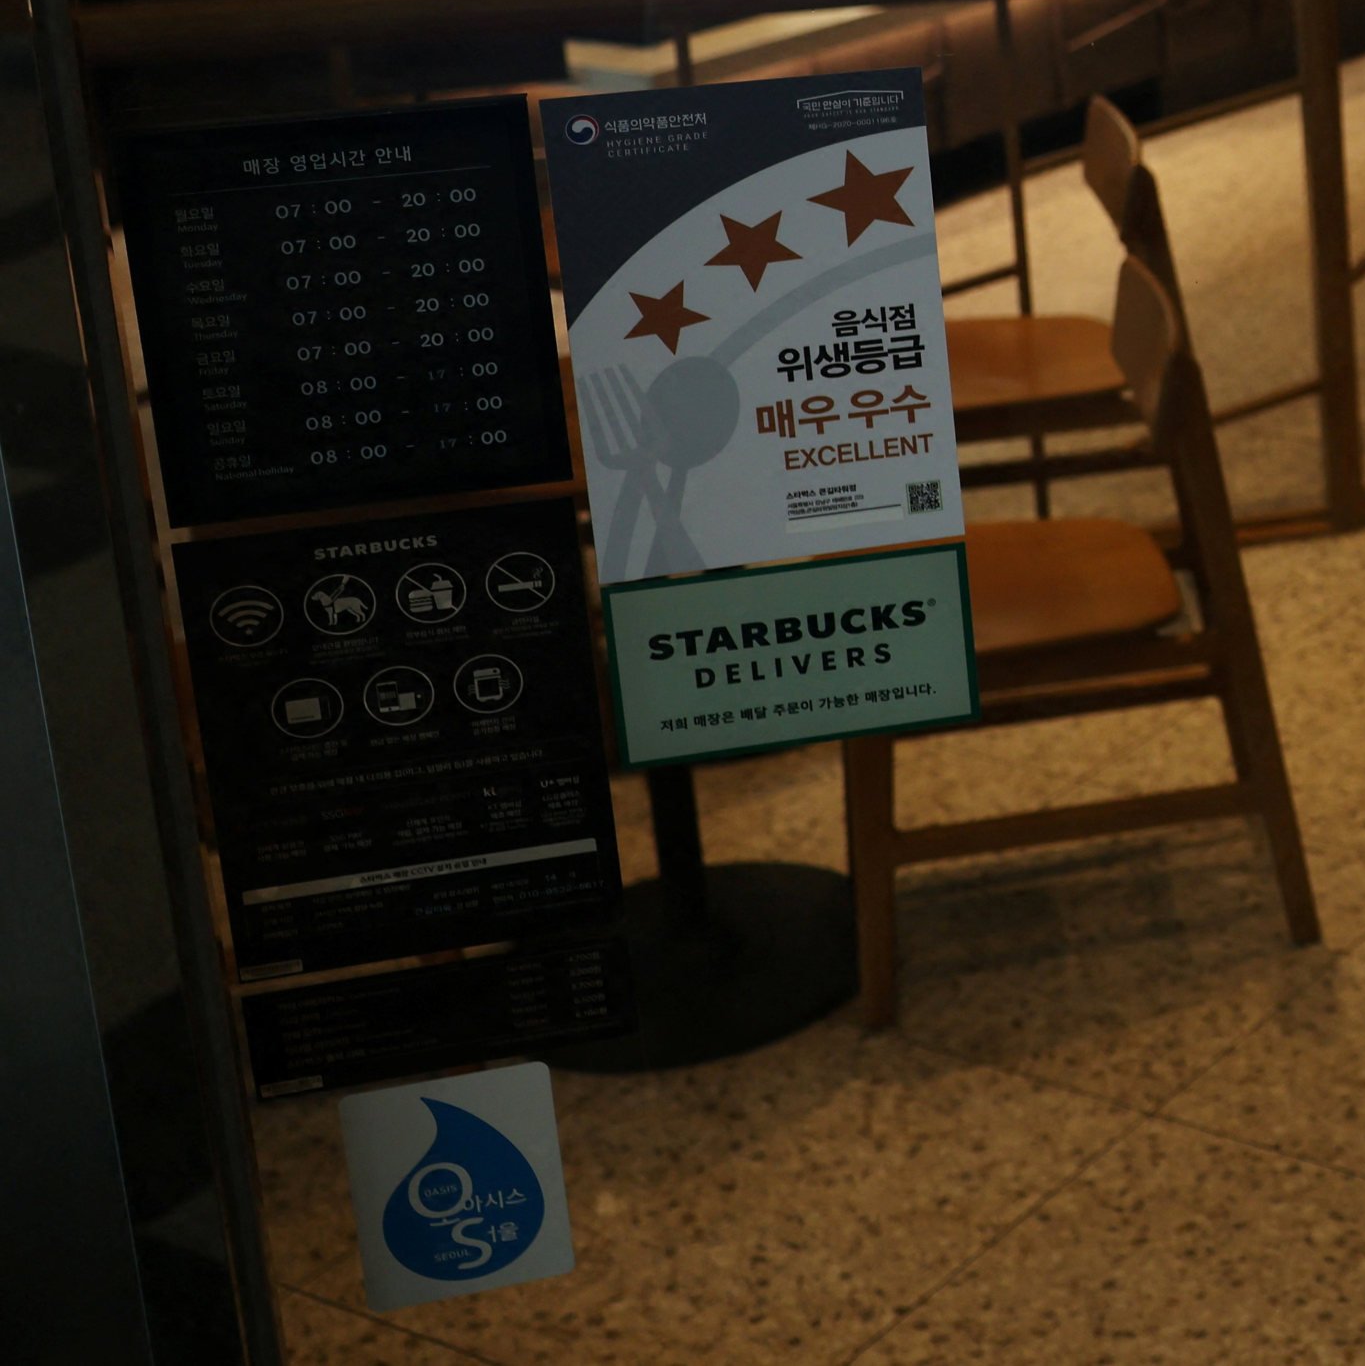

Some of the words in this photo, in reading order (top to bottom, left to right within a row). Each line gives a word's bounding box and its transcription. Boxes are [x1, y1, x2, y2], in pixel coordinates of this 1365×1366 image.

[853, 94, 899, 107] 기준입니다
[604, 112, 708, 133] 식품의약품안전처
[606, 136, 662, 148] HYGIENE
[668, 131, 708, 142] GRADE
[608, 144, 689, 158] CERTIFICATE
[243, 159, 281, 177] 매장
[290, 149, 366, 172] 영업시간
[375, 145, 412, 163] 안내
[276, 204, 301, 219] 07
[324, 199, 351, 214] 00
[401, 192, 425, 207] 20
[450, 188, 476, 203] 00
[177, 223, 218, 234] Monday
[281, 240, 306, 255] 07
[329, 235, 356, 250] 00
[406, 228, 431, 243] 20
[455, 224, 480, 238] 00
[286, 275, 311, 290] 07
[335, 271, 361, 286] 00
[411, 263, 435, 278] 20
[459, 259, 485, 273] 00
[187, 293, 247, 306] Wednesday
[292, 311, 317, 326] 07
[340, 306, 366, 321] 00
[416, 298, 439, 312] 20
[463, 293, 489, 308] 00
[832, 304, 916, 337] 음식점
[297, 347, 322, 361] 07
[344, 341, 371, 356] 00
[420, 333, 444, 347] 20
[468, 327, 493, 342] 00
[777, 335, 925, 382] 위생등급
[301, 381, 327, 396] 08
[350, 376, 376, 391] 00
[472, 362, 498, 377] 00
[306, 416, 332, 431] 08
[355, 411, 382, 425] 00
[477, 396, 502, 411] 00
[756, 396, 840, 438] 매우
[848, 385, 931, 428] 우수
[311, 450, 337, 465] 08
[360, 445, 387, 459] 00
[481, 431, 507, 445] 00
[784, 434, 933, 470] EXCELLENT
[313, 534, 439, 561] STARBUCKS
[695, 643, 891, 688] DELIVERS
[660, 718, 688, 732] 저희
[694, 711, 734, 727] 매장은
[741, 707, 767, 721] 배달
[773, 700, 813, 717] 주문이
[819, 694, 858, 709] 가능한
[865, 683, 937, 704] 매장입니다.
[424, 1183, 458, 1198] OASIS
[434, 1248, 472, 1263] SEOUL
